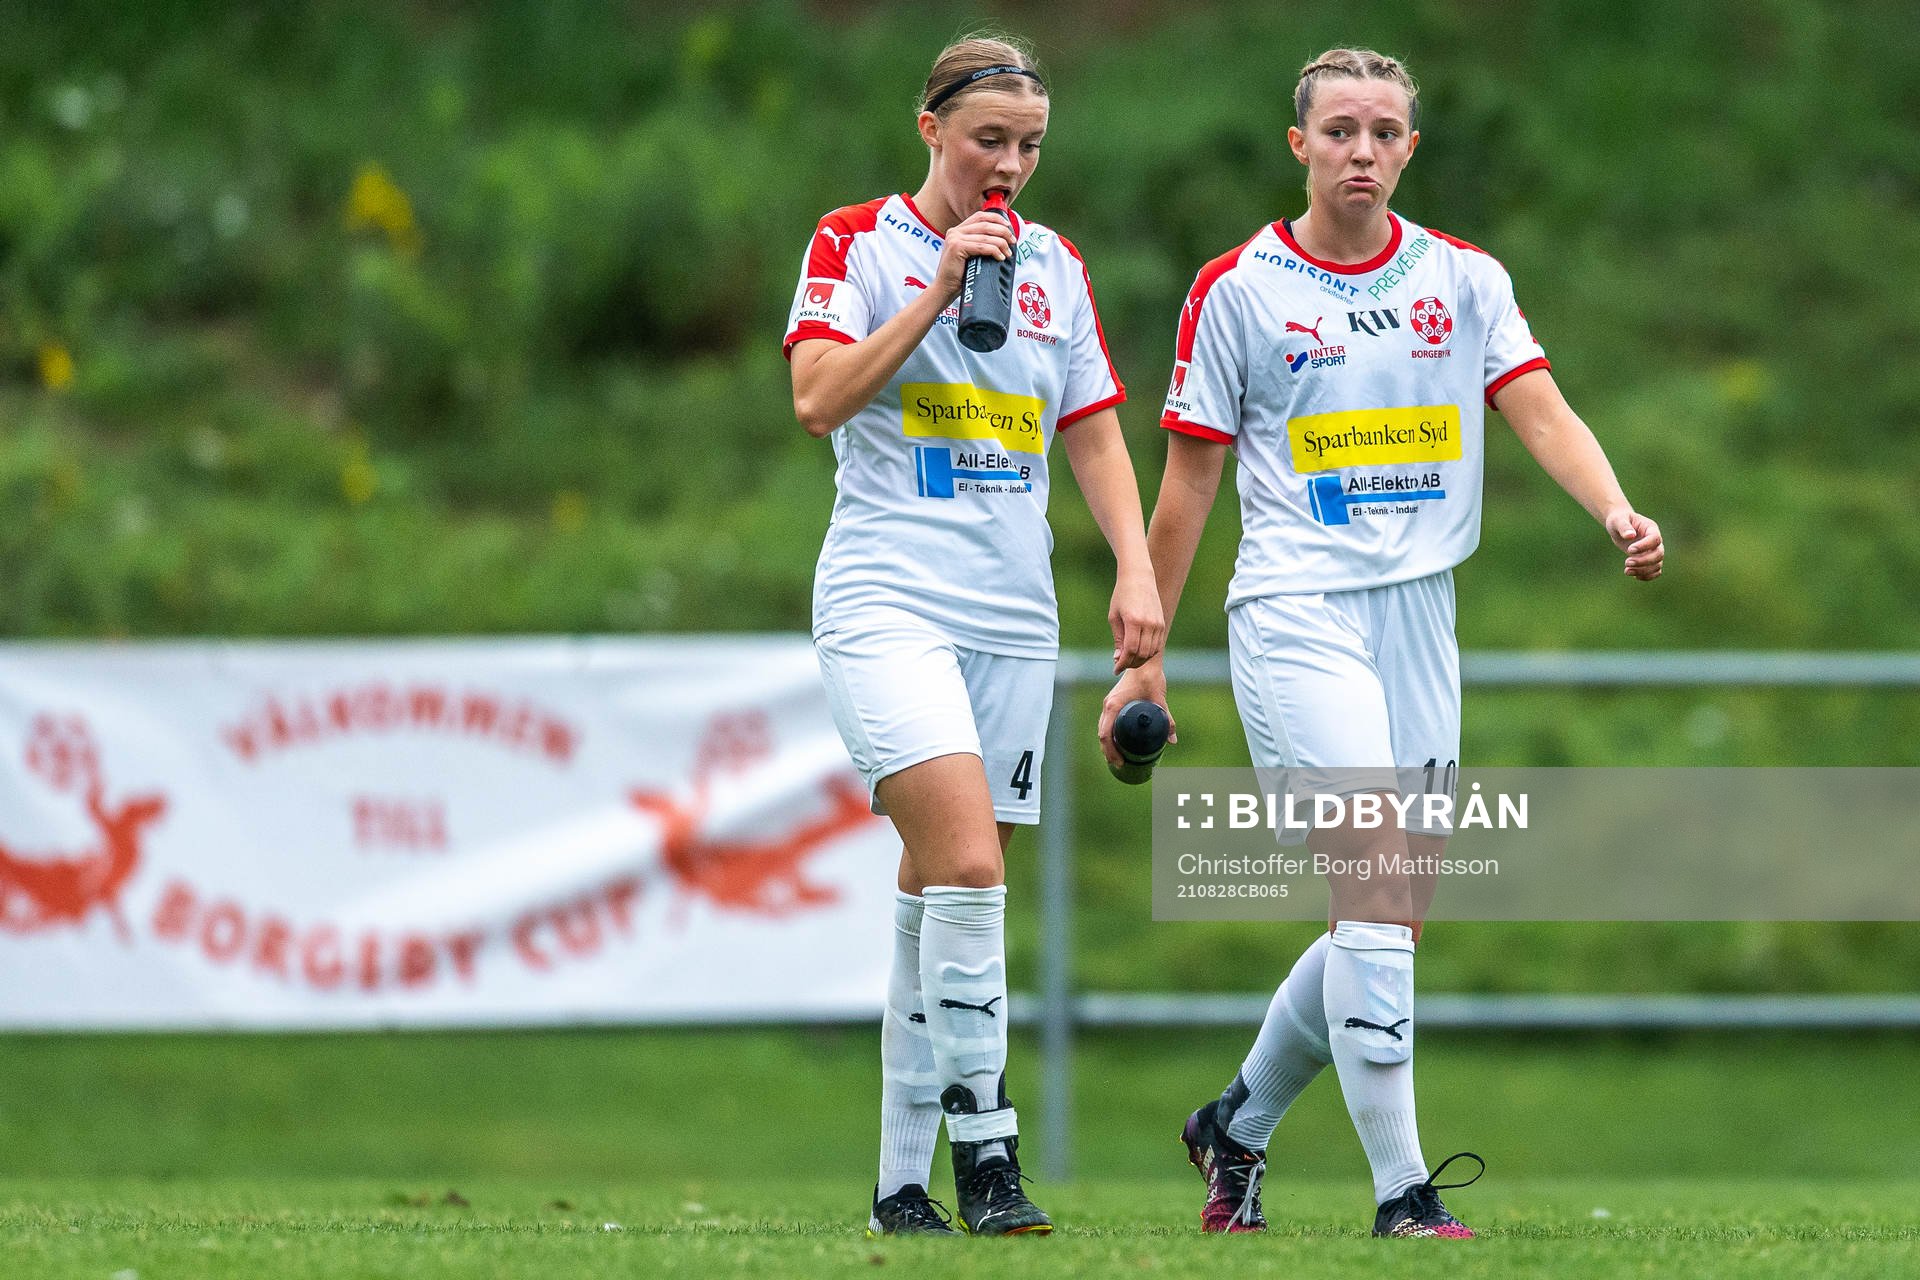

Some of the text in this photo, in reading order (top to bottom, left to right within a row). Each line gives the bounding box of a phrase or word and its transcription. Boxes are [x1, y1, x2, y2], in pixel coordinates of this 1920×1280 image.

[884, 214, 942, 251] HORIS
[963, 258, 977, 303] OPTIME
[1254, 250, 1359, 297] HORISONT
[822, 312, 841, 323] SPEL
[933, 315, 959, 326] PORT
[1309, 345, 1345, 359] INTER
[1311, 355, 1347, 369] SPORT
[916, 396, 1013, 431] Sparbaen
[1175, 400, 1191, 411] SPEL
[1303, 420, 1448, 457] Sparbanken Syd
[957, 452, 1031, 480] All-Ele B
[958, 482, 967, 492] El
[974, 484, 1003, 494] Teknik
[1421, 473, 1441, 488] AB
[1352, 507, 1362, 516] El
[1010, 750, 1034, 800] 4
[1422, 758, 1456, 800] 10
[351, 795, 447, 851] TILL
